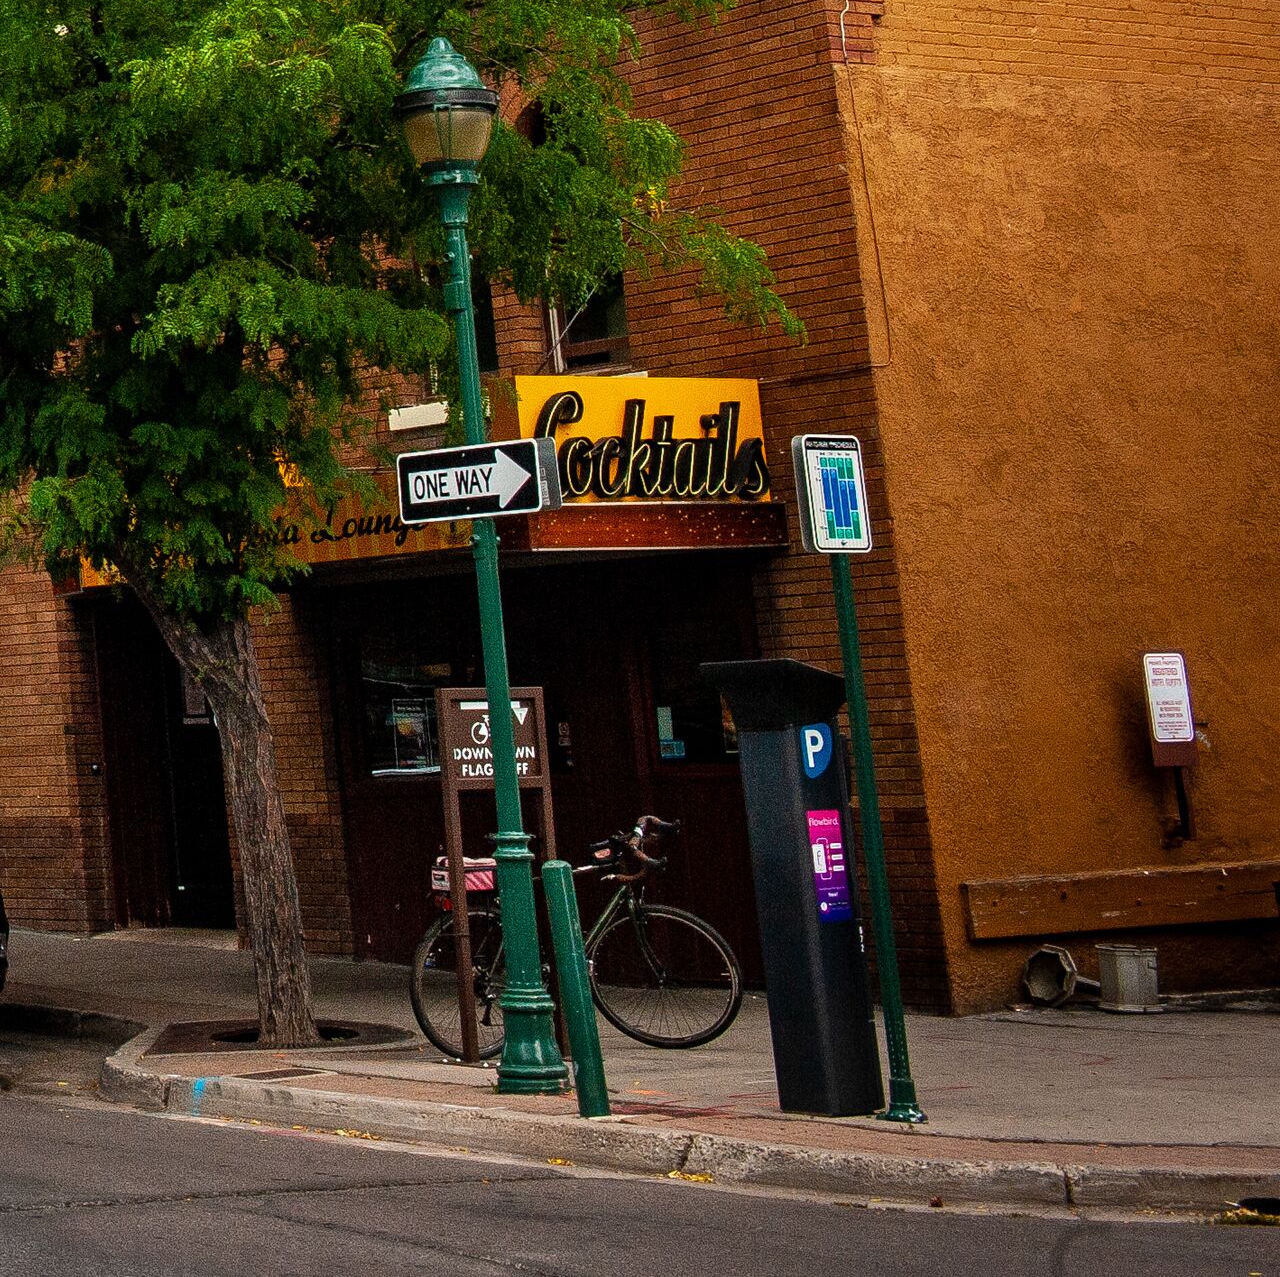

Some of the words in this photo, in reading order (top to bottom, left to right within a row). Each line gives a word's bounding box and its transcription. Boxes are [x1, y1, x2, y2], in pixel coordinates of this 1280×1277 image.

[534, 390, 770, 499] Cocktails
[414, 472, 450, 500] ONE
[455, 467, 493, 495] WAY
[453, 746, 536, 761] DOWNWN
[805, 730, 824, 768] P
[462, 763, 529, 777] FLAGFF
